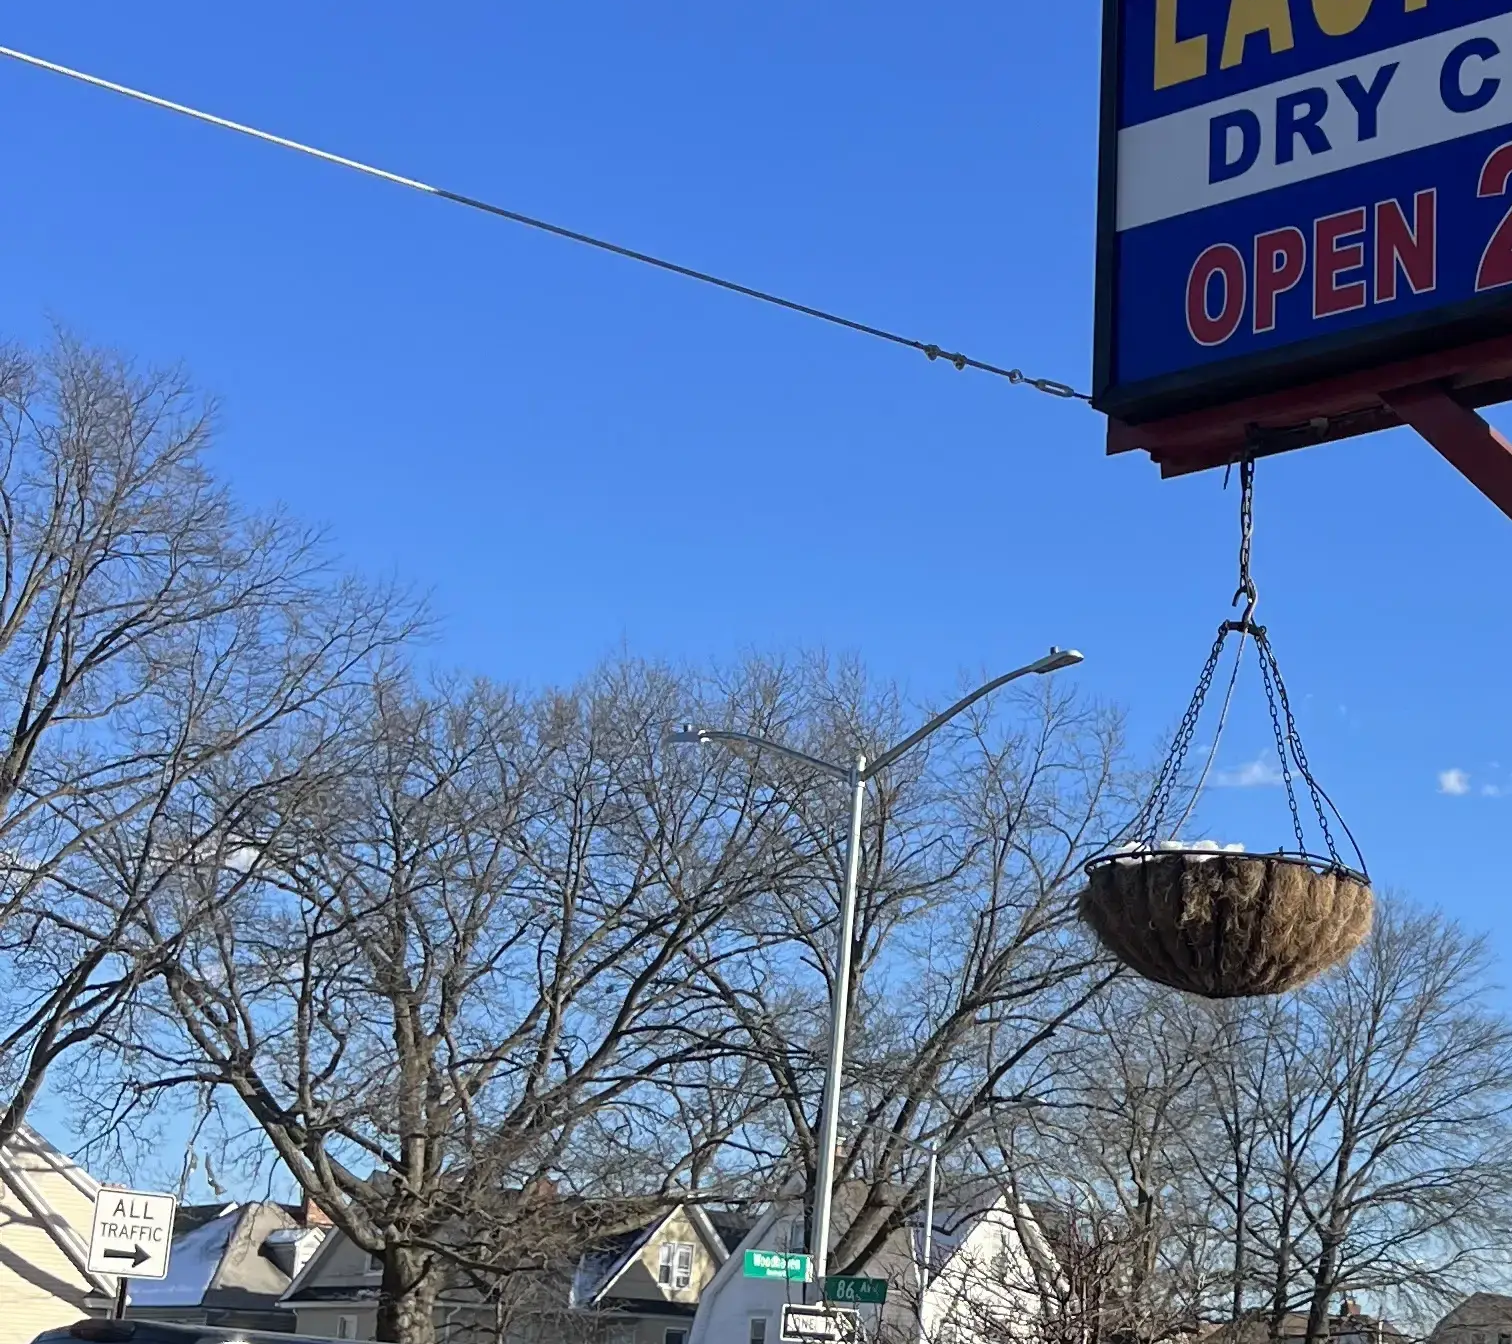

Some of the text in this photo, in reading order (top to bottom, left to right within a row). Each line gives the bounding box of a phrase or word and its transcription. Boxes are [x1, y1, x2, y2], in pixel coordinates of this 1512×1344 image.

[1208, 61, 1399, 185] DRY
[1184, 187, 1437, 346] OPEN
[112, 1199, 154, 1220] ALL
[101, 1222, 163, 1242] TRAFFIC
[836, 1279, 854, 1302] 86
